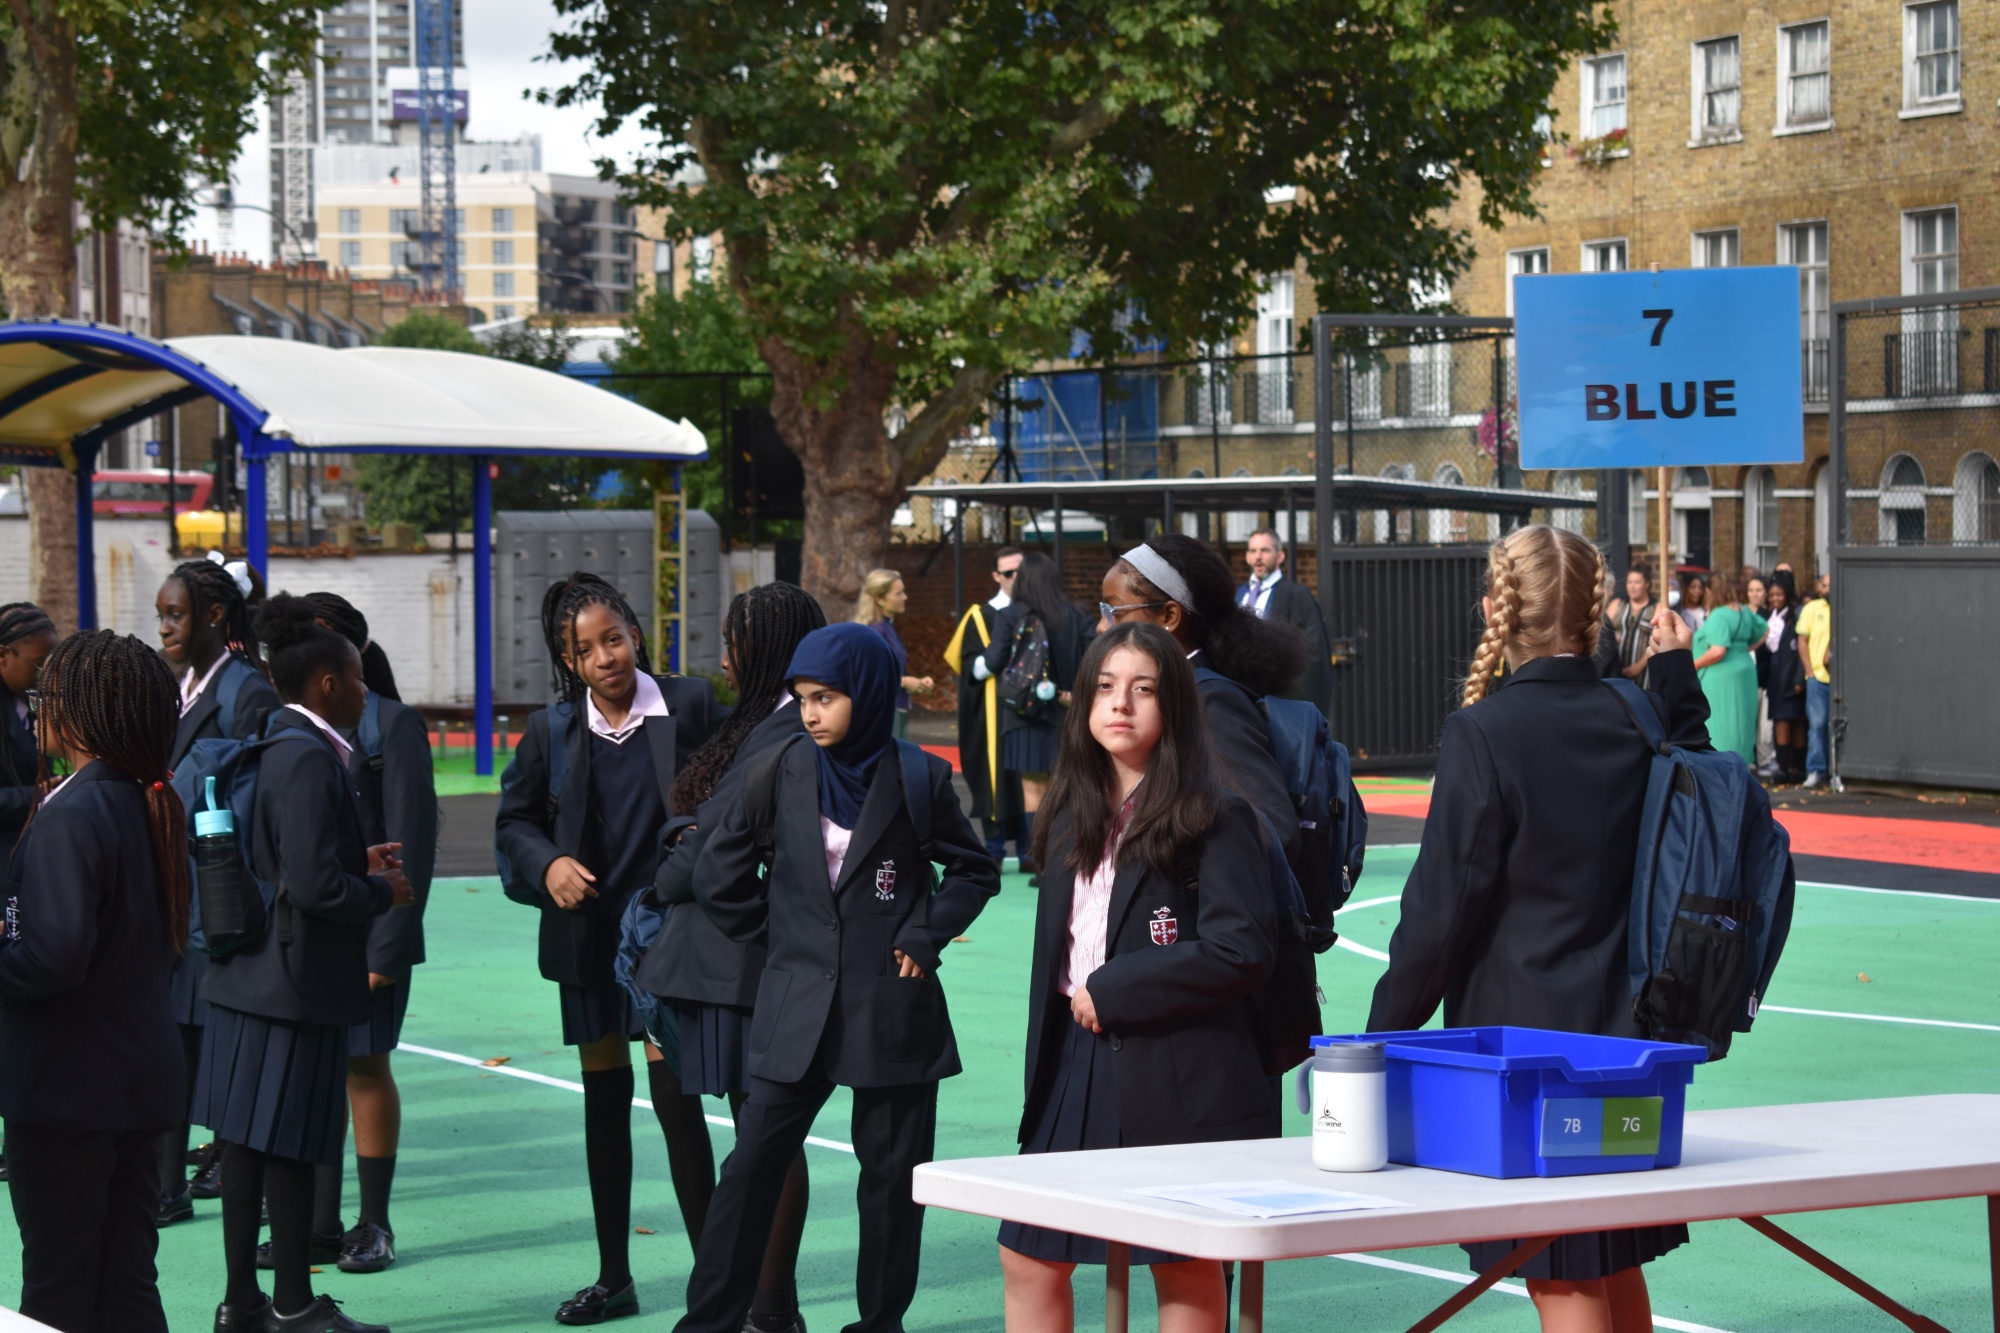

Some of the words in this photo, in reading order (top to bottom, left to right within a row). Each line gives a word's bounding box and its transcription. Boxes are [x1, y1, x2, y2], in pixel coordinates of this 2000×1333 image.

[1642, 309, 1674, 346] 7
[1585, 380, 1737, 421] BLUE
[1563, 1118, 1581, 1133] 7B
[1622, 1117, 1640, 1132] 7G
